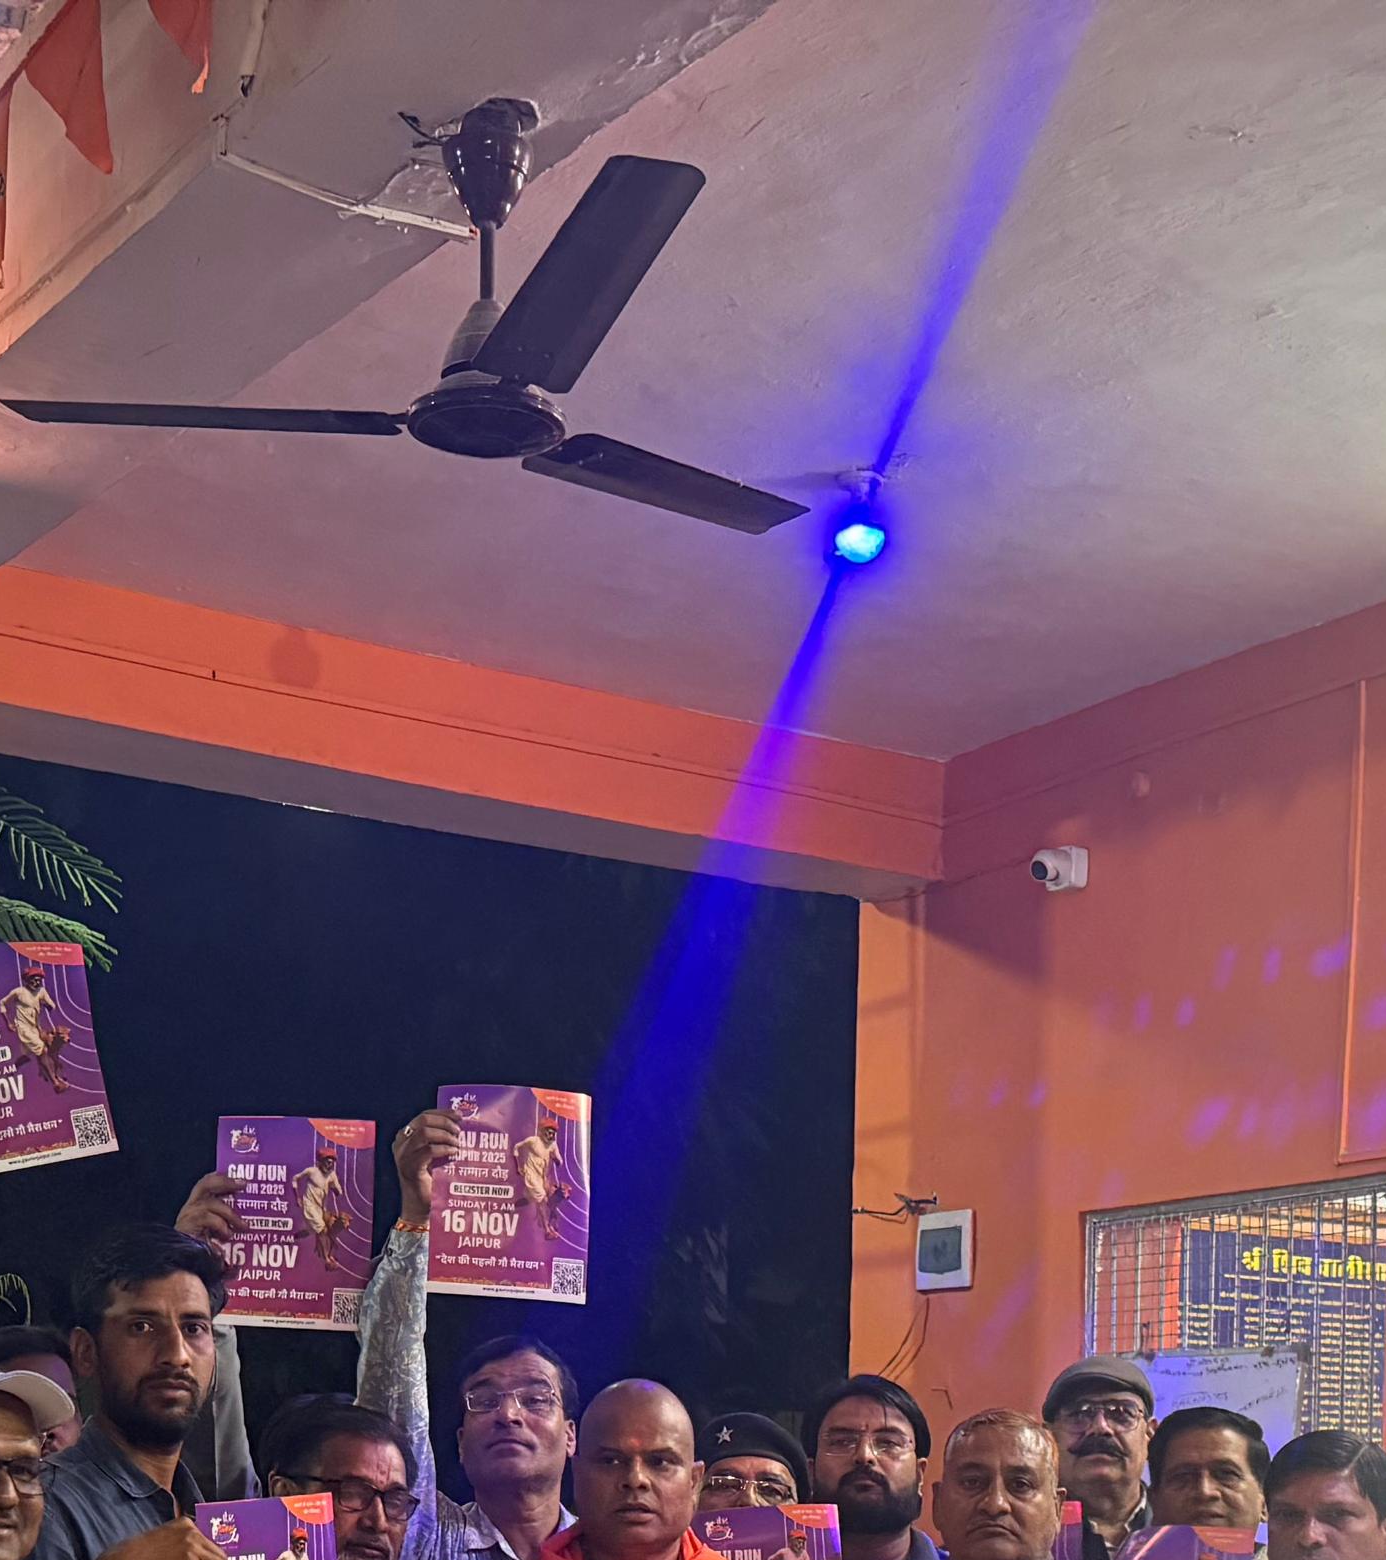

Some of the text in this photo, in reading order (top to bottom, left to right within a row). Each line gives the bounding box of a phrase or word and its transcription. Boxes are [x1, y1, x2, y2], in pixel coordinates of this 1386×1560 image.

[479, 1132, 509, 1150] RUN
[258, 1165, 286, 1182] RUN
[442, 1210, 519, 1236] 16 NOV
[458, 1236, 501, 1248] JAIPUR
[252, 1245, 298, 1268] NOV
[238, 1269, 281, 1281] JAIPUR
